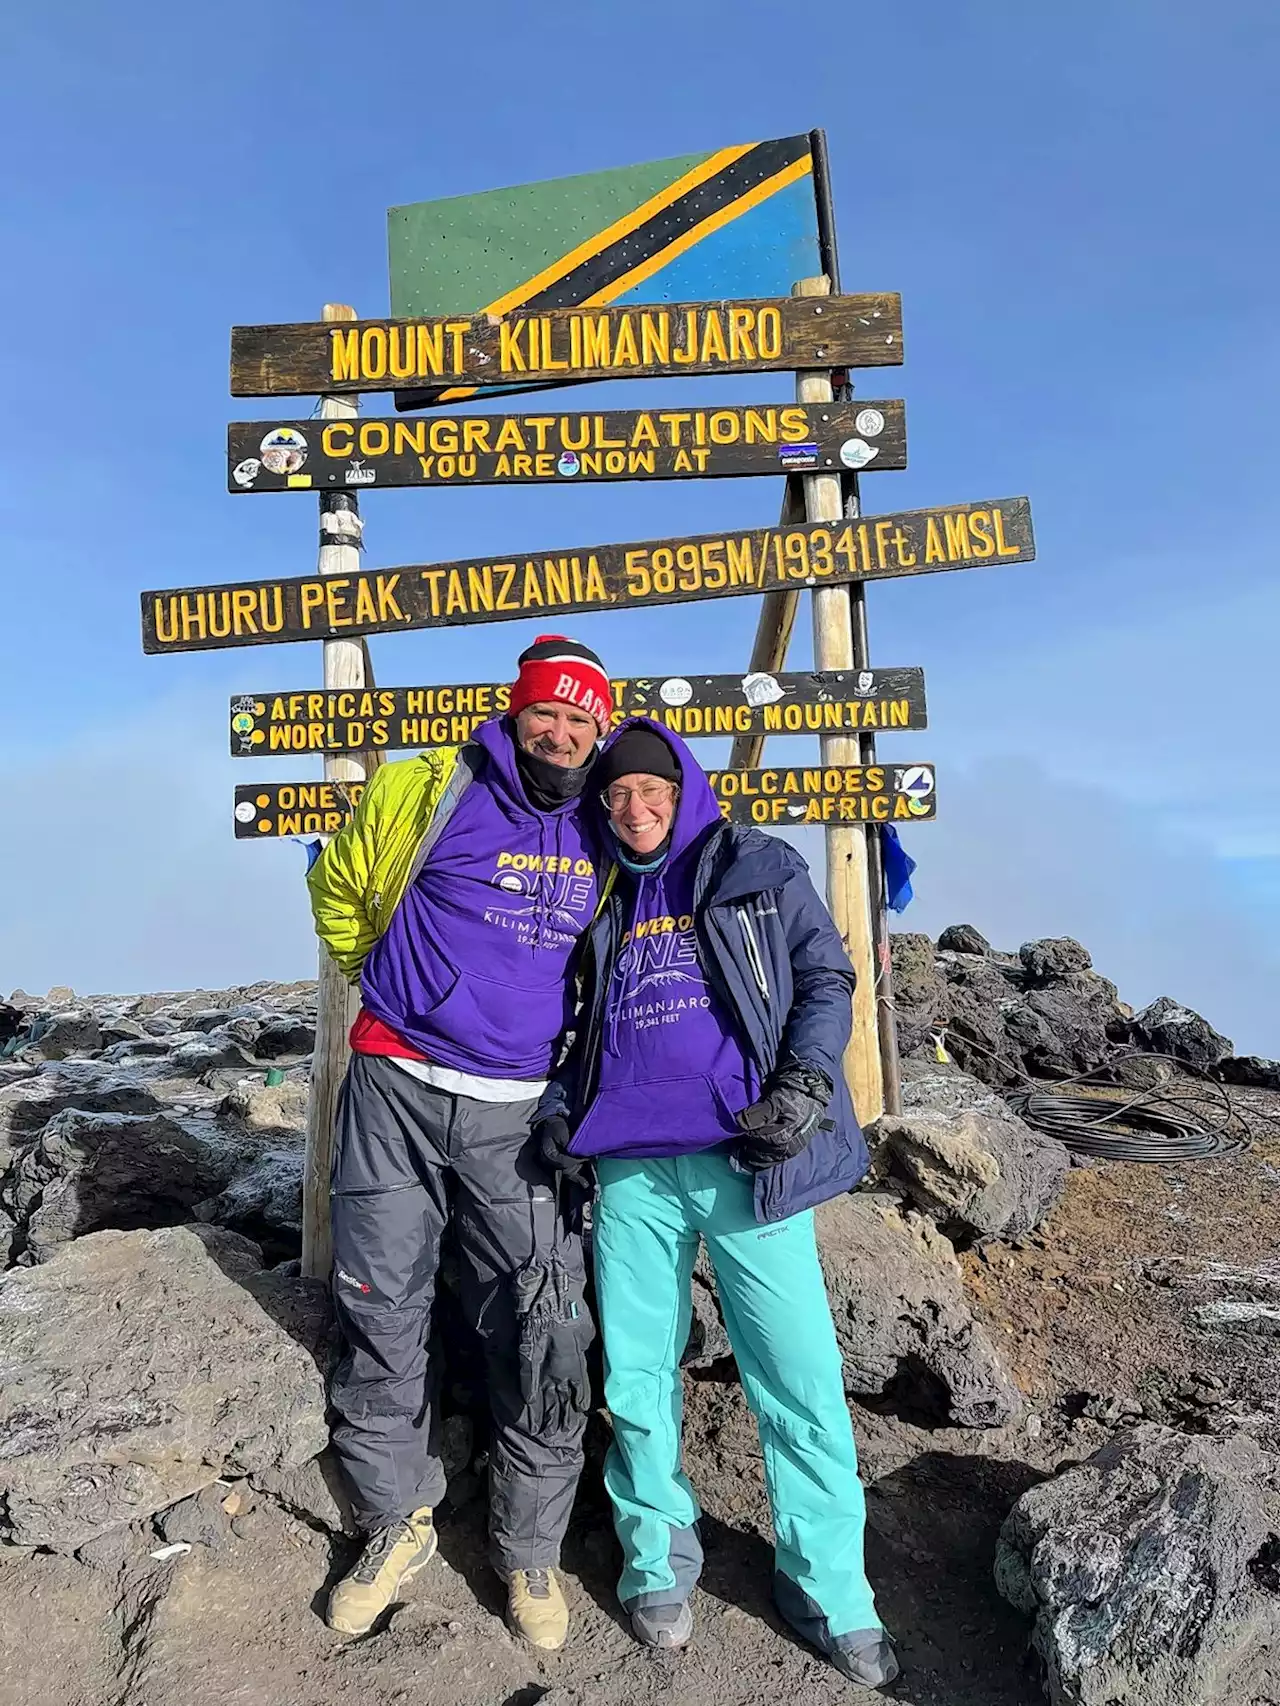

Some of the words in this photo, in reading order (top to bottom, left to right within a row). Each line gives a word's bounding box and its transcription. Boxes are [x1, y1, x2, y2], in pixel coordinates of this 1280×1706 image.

[331, 322, 472, 382] MOUNT
[499, 306, 783, 373] KILIMANJARO
[320, 407, 811, 458] CONGRATULATIONS
[418, 453, 477, 479] YOU
[494, 452, 556, 478] ARE
[580, 450, 656, 476] NOW
[673, 448, 712, 473] AT
[153, 585, 284, 643] UHURU
[300, 573, 412, 631] PEAK,
[421, 554, 618, 618] TANZANIA,
[924, 509, 1021, 565] AMSL
[269, 690, 397, 721] AFRICA'S
[407, 686, 512, 715] HIGHES
[763, 699, 910, 732] MOUNTAIN
[268, 719, 390, 750] WORLD'S
[400, 714, 489, 744] HIGHE
[277, 785, 337, 810] ONE
[752, 798, 788, 823] OF
[804, 795, 912, 821] AFRICA
[496, 851, 572, 874] POWER
[490, 868, 594, 912] ONE
[620, 915, 677, 948] PWER
[677, 914, 695, 930] O
[612, 928, 698, 981] ONE
[608, 995, 711, 1025] KLIMANJARO
[661, 1013, 681, 1025] FEET
